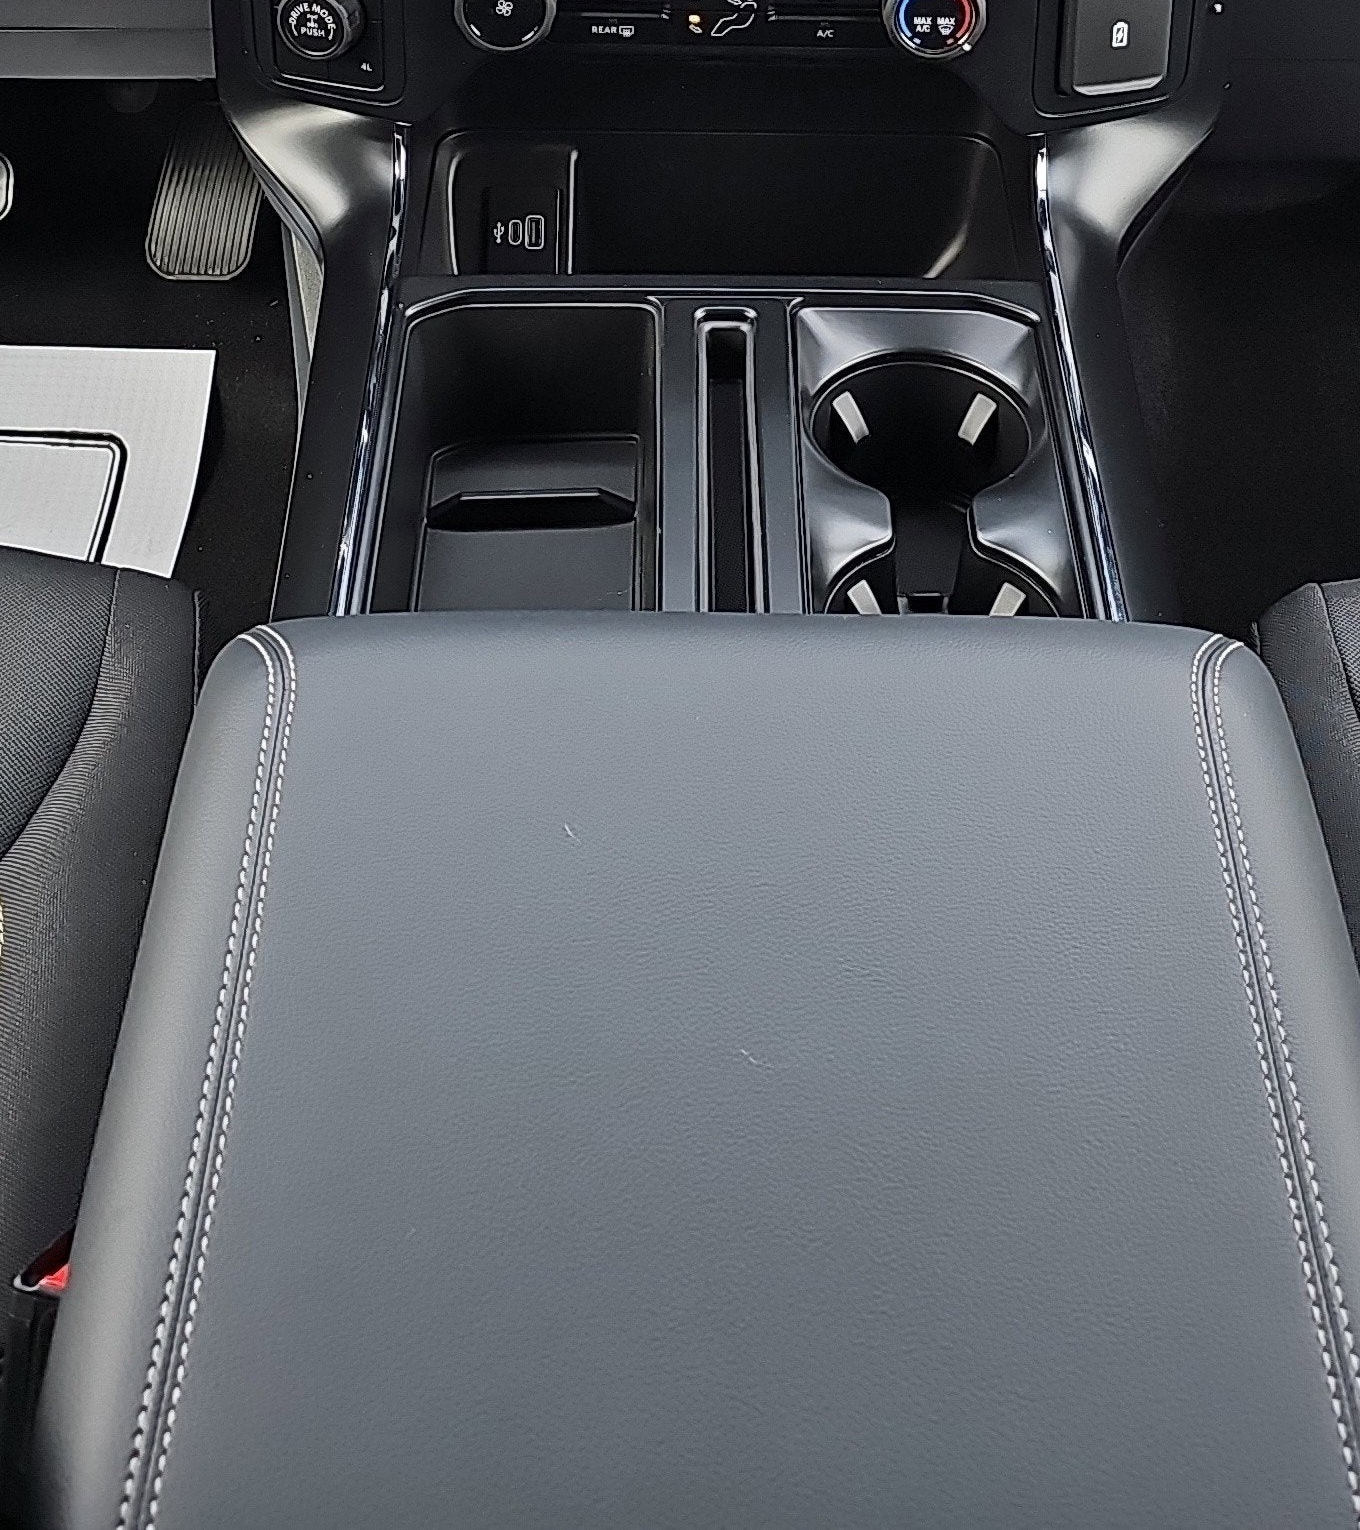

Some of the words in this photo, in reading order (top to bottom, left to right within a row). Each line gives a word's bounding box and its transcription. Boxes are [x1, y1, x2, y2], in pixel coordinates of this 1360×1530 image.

[288, 2, 310, 25] DRIVE
[312, 3, 337, 30] MODE
[913, 17, 933, 25] MAX
[936, 17, 956, 26] MAX
[300, 26, 326, 38] PUSH
[591, 25, 618, 34] REAR
[816, 29, 835, 38] A/C
[915, 25, 931, 33] A/C
[360, 62, 373, 71] 4L
